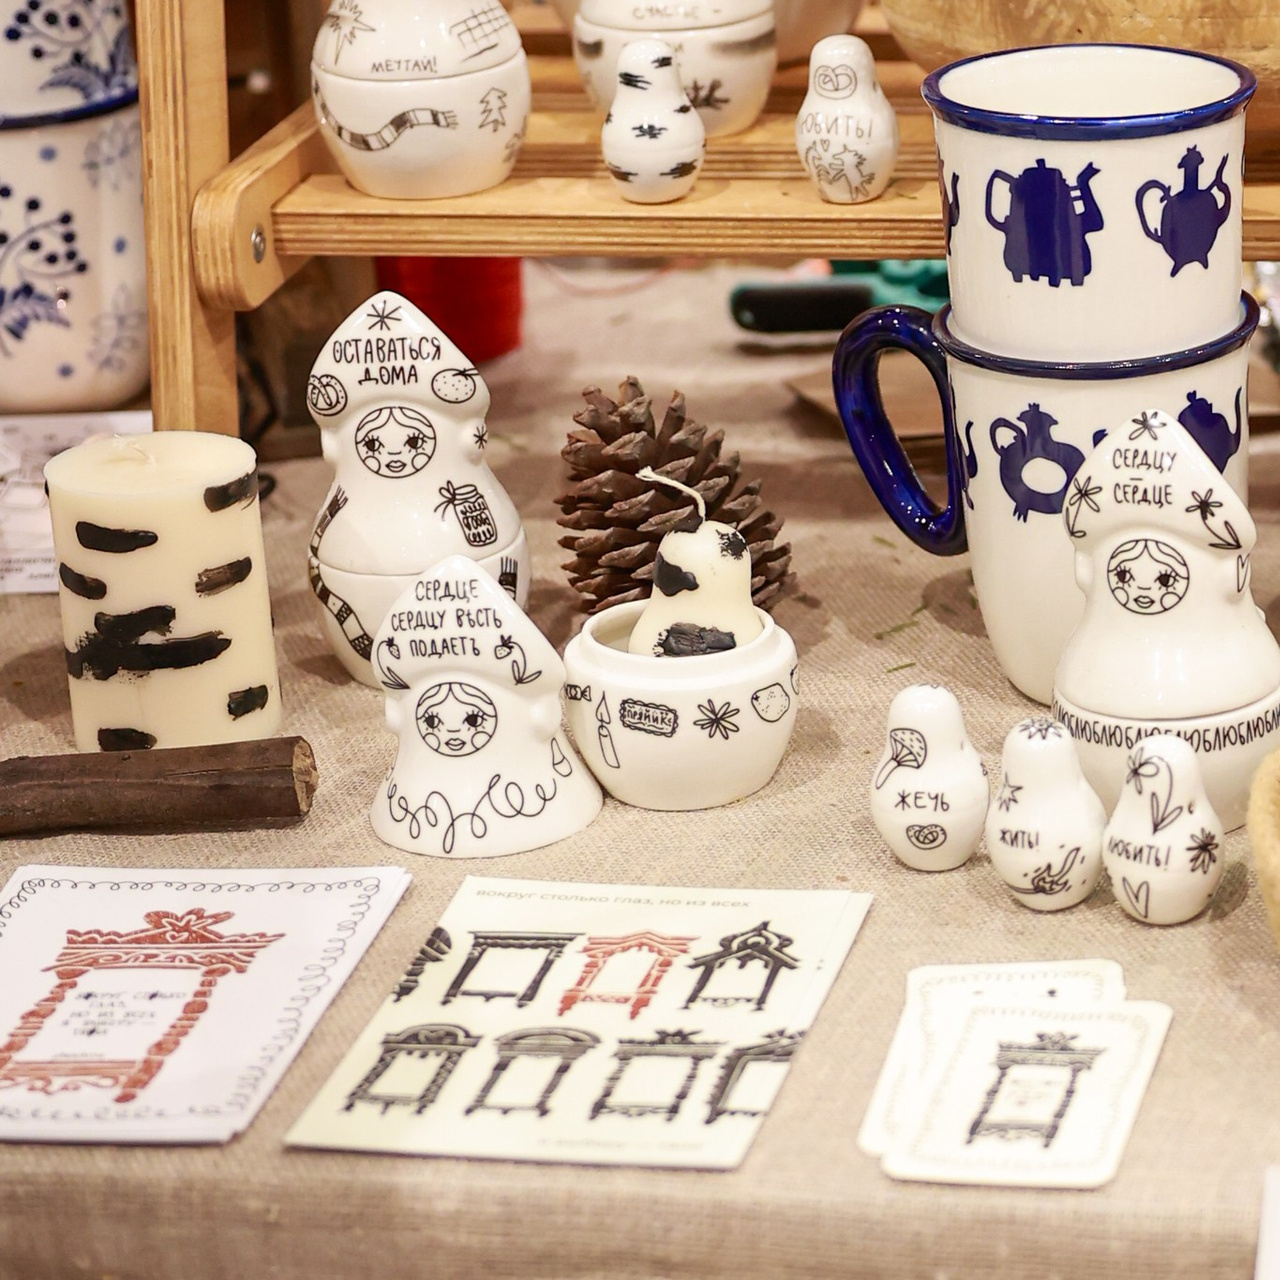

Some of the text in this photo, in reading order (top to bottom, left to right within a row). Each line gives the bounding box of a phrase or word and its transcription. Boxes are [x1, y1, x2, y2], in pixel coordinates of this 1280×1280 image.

[371, 55, 438, 74] МЕЧТАЙ!
[332, 336, 441, 364] ОСТАВАТЬСЯ
[357, 364, 418, 385] ДОМА
[1112, 448, 1177, 474] СЕРДЦУ
[1113, 482, 1173, 509] СЕРДЦЕ
[415, 579, 479, 603] СЕРДЦЕ
[391, 609, 446, 632] СЕРДЦУ
[894, 788, 950, 812] ЖЕЧЬ
[999, 828, 1040, 852] ЖИТЬ!
